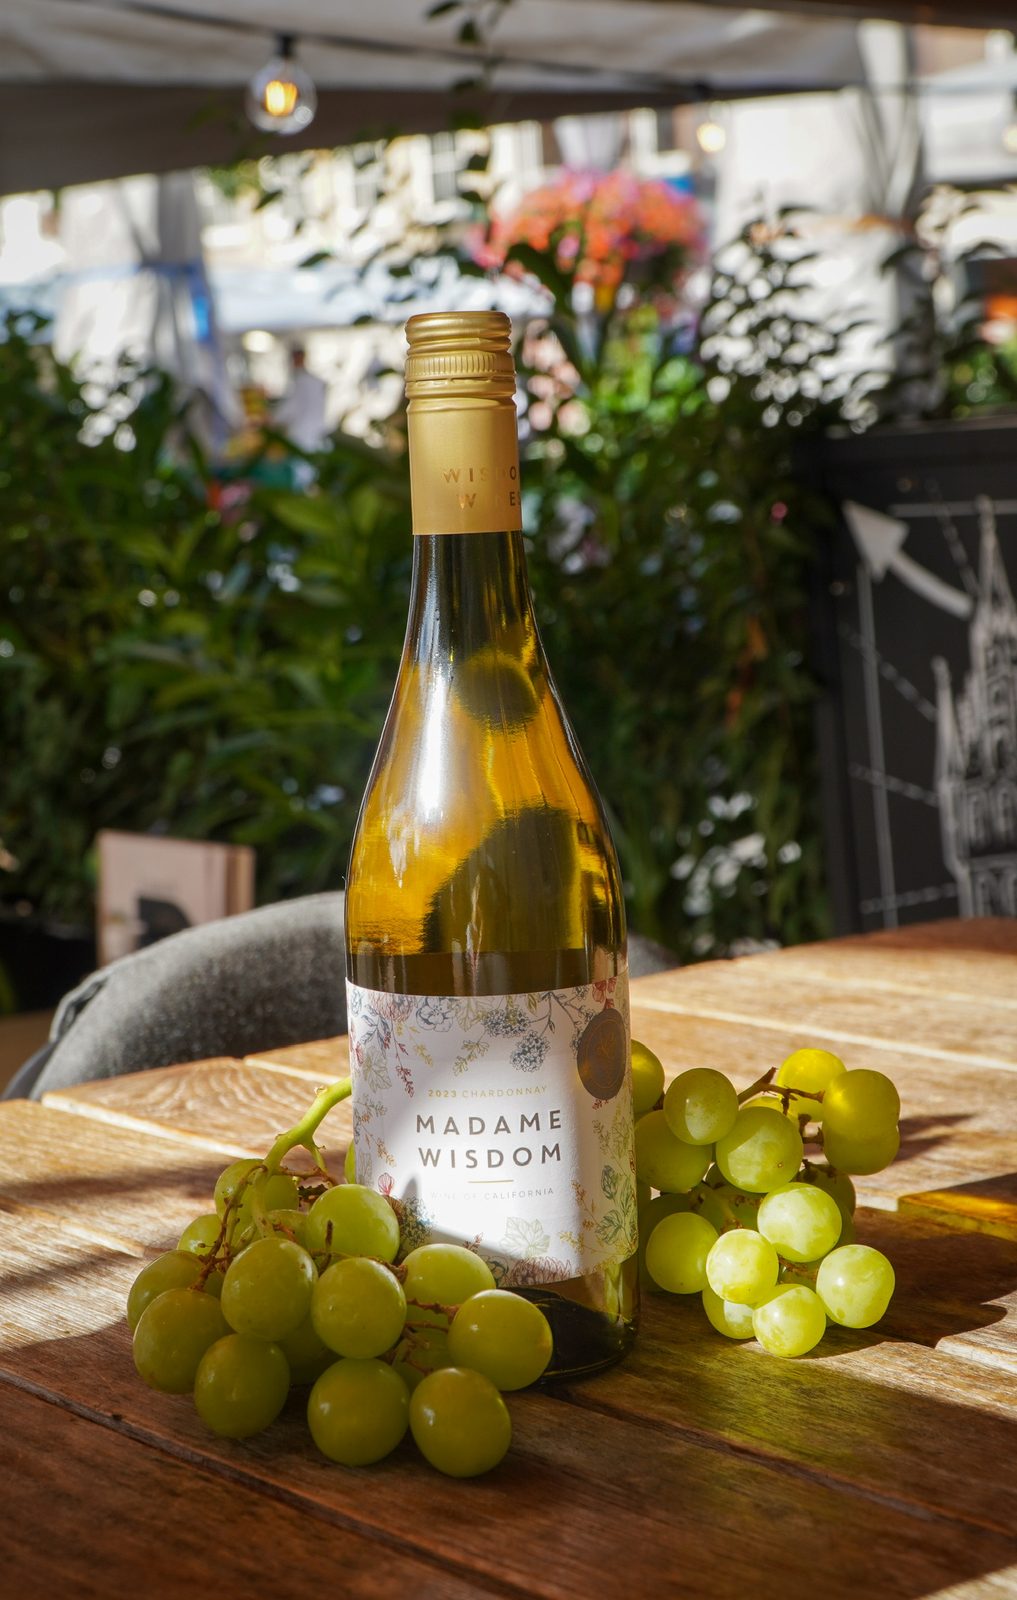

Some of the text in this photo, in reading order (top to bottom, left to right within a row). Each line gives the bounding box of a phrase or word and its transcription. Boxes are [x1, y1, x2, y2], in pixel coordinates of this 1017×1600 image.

[428, 1085, 547, 1098] 2023 CHARDONNAY
[416, 1109, 561, 1135] MADAME
[418, 1143, 561, 1168] WISDOM
[484, 1187, 554, 1200] CALIFORNIA
